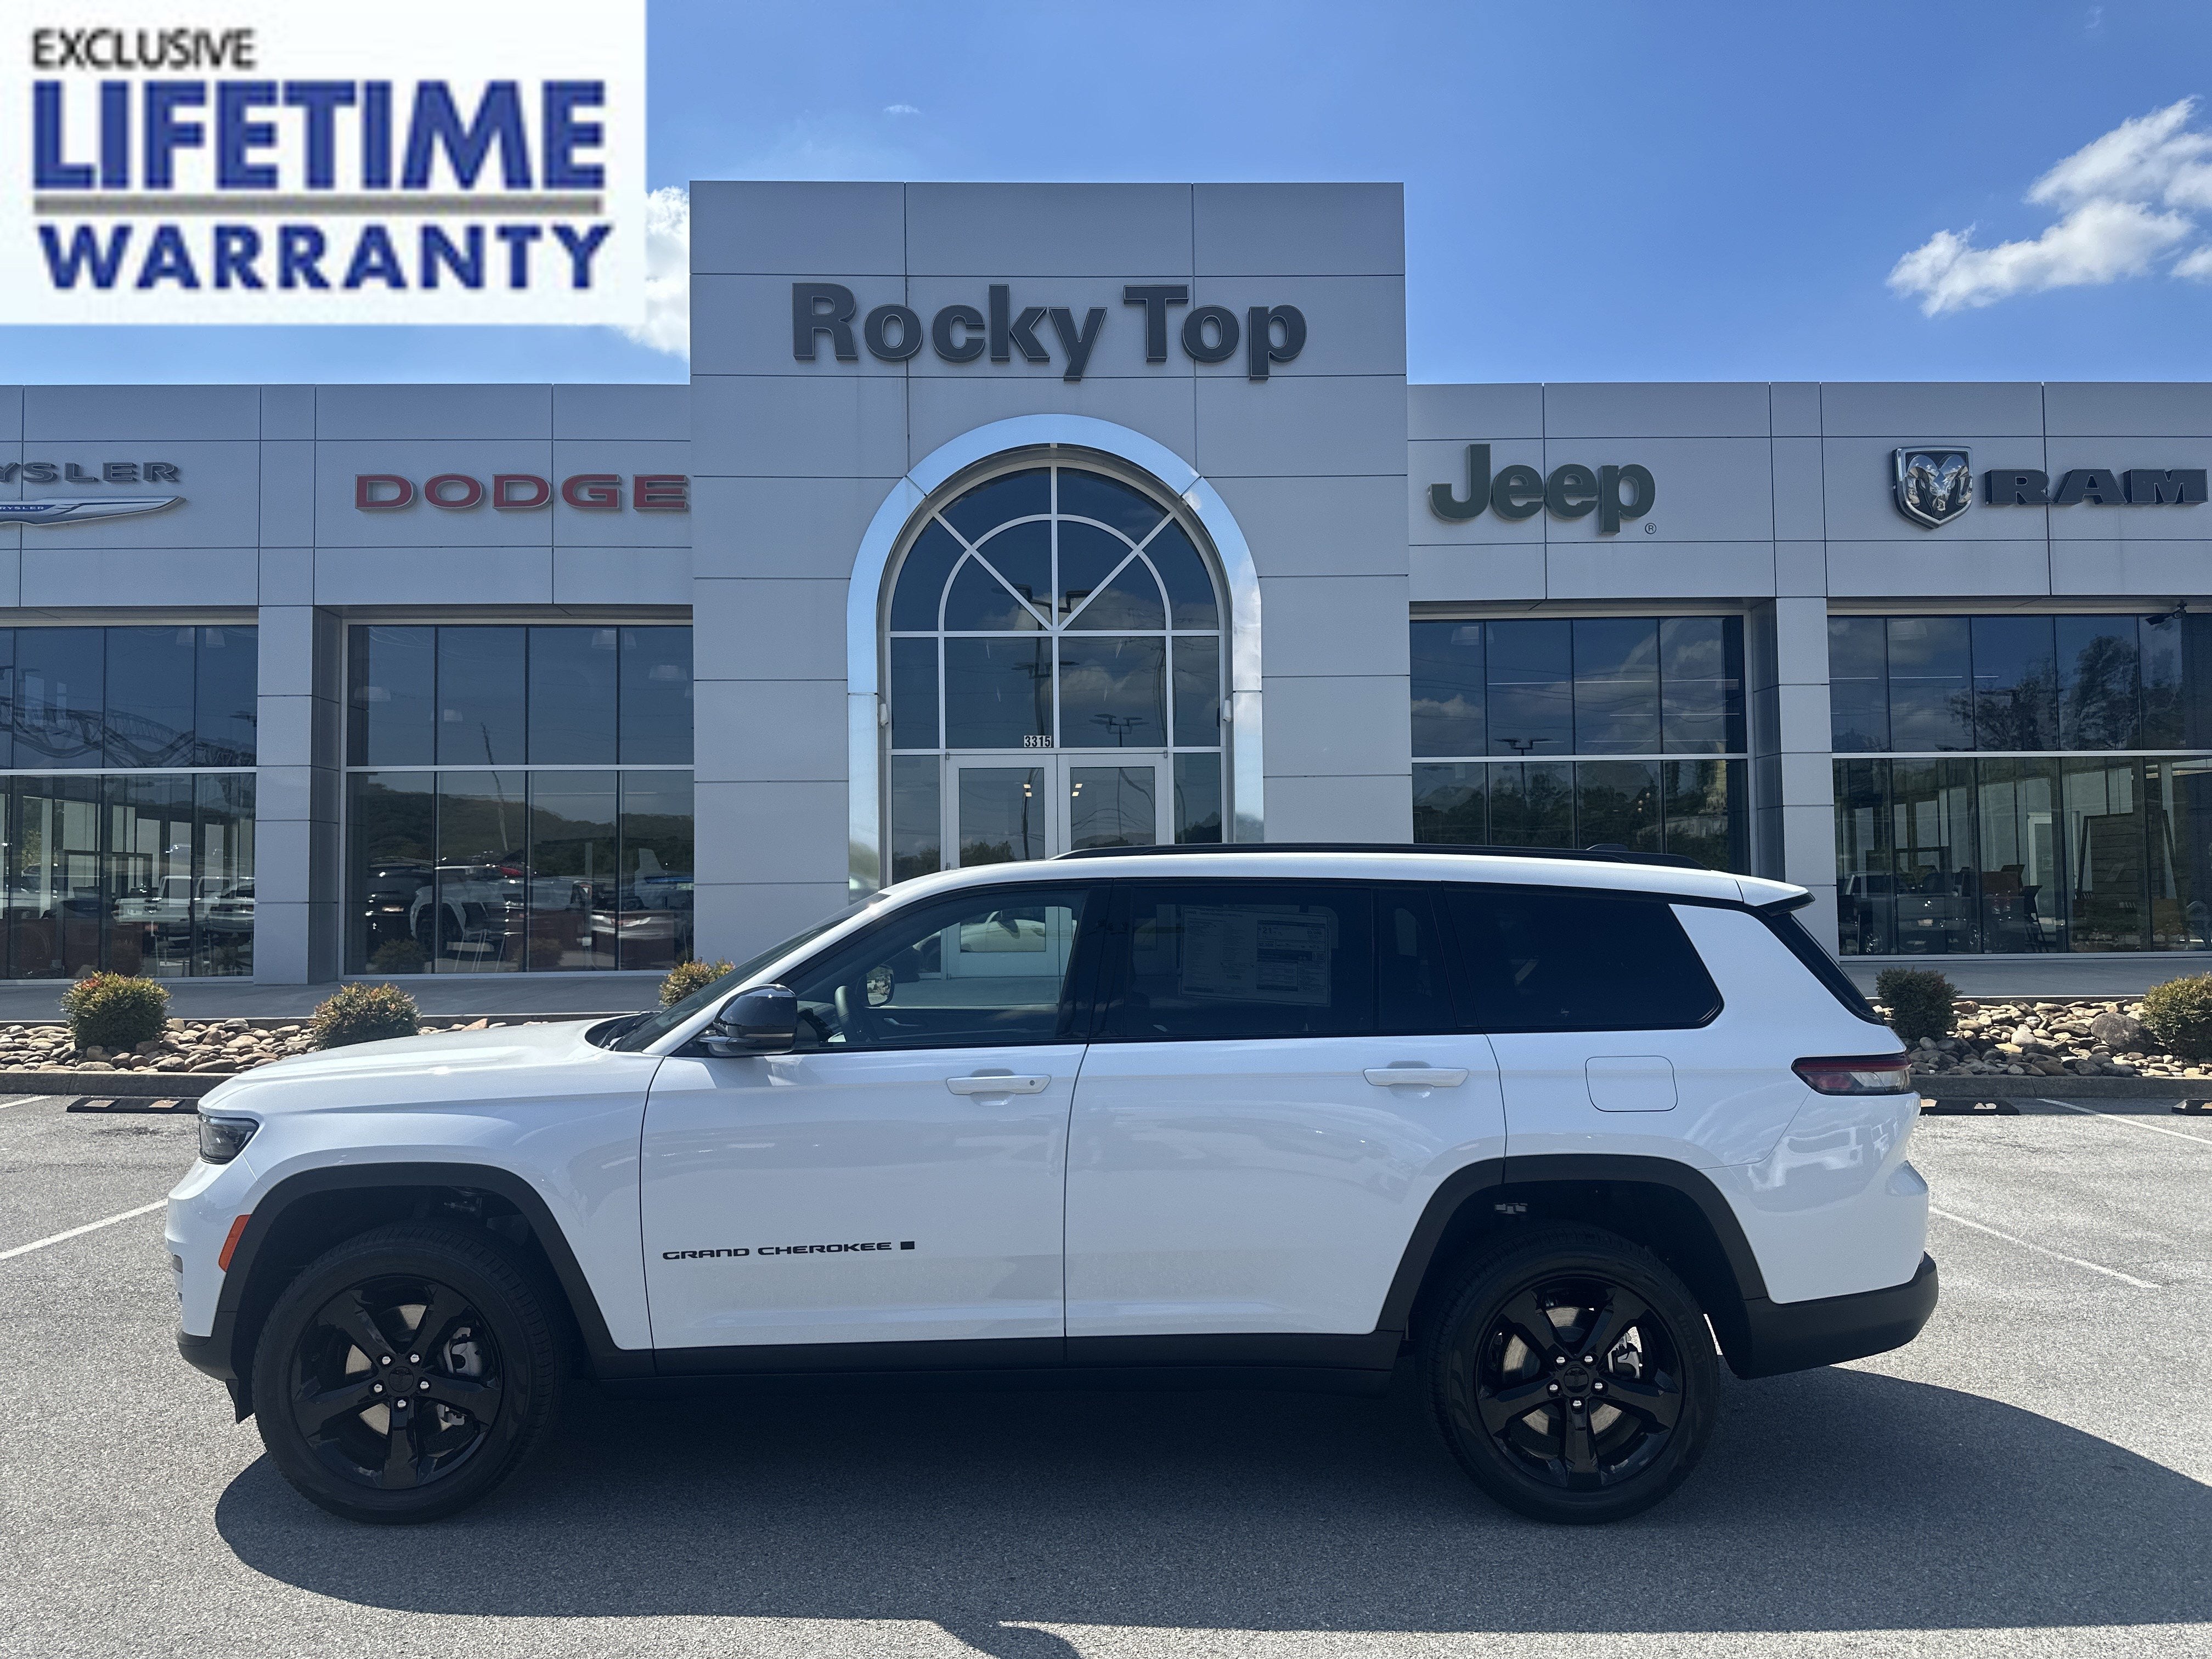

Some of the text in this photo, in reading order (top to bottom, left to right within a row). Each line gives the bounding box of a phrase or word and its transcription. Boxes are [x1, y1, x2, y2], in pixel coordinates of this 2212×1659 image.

[792, 282, 1307, 381] Rocky Top
[355, 474, 688, 510] DODGE
[1429, 443, 1656, 535] Jeep
[1985, 469, 2208, 505] RAM
[1025, 736, 1051, 747] 3315
[663, 1242, 891, 1260] GRAND CHEROKEE
